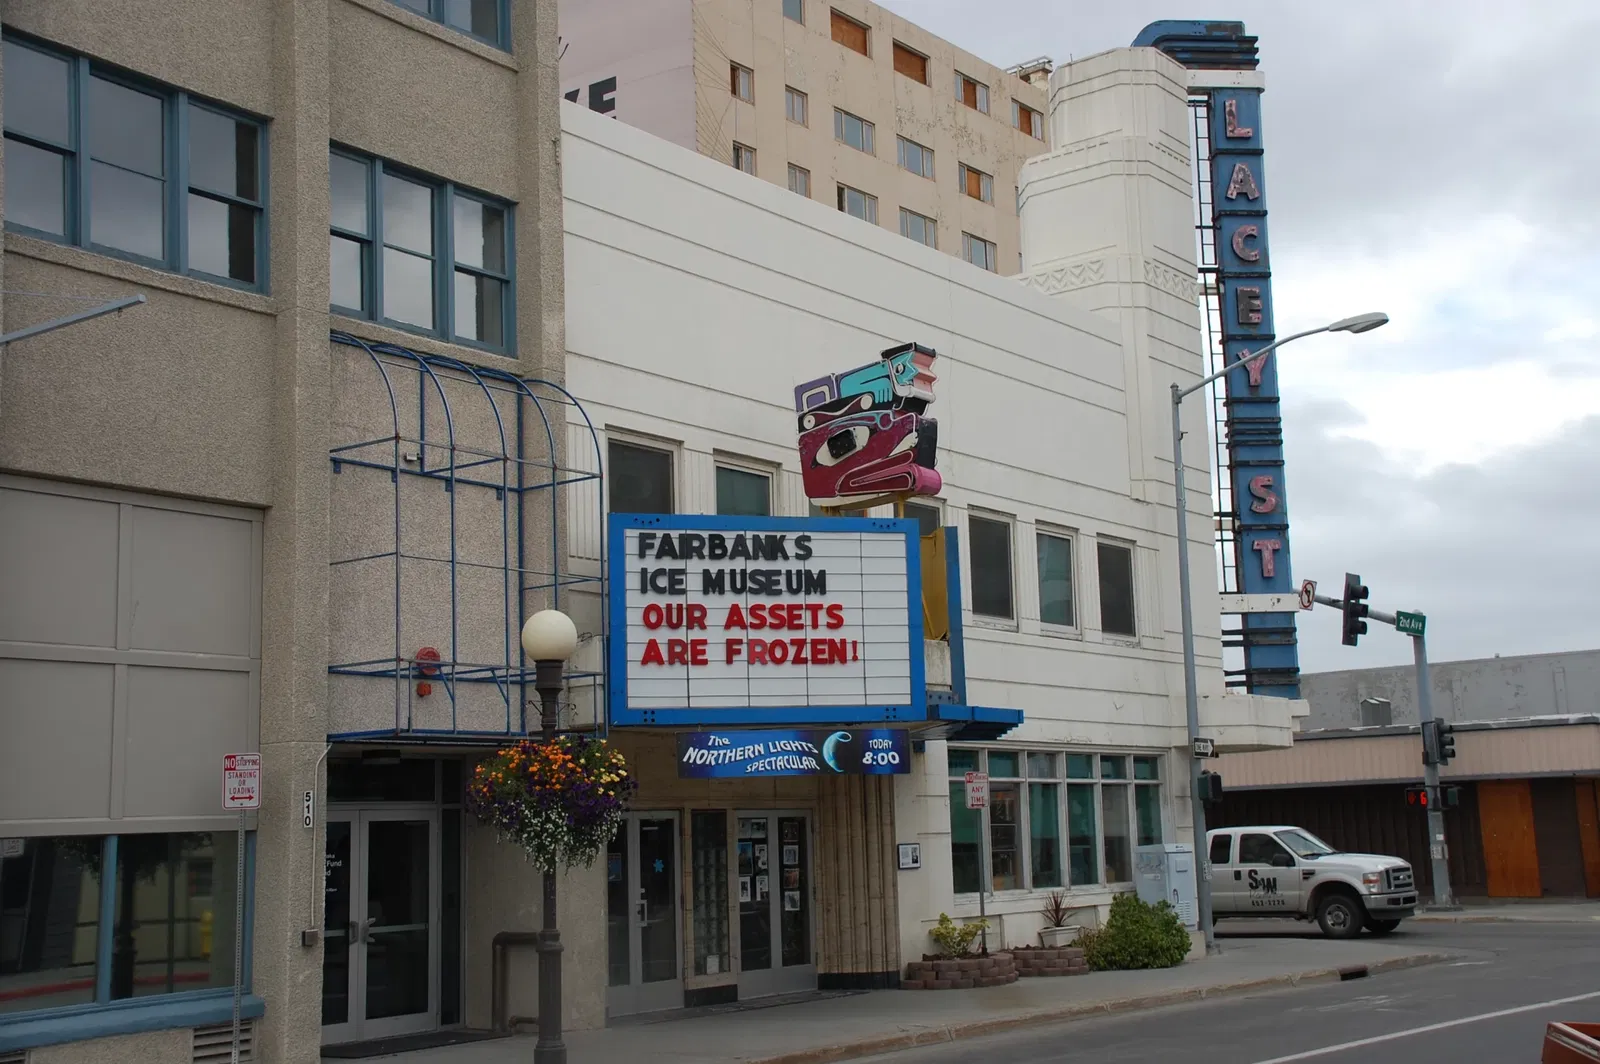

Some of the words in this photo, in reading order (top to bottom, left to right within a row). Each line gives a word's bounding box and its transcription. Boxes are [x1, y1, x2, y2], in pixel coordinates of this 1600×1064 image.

[1224, 99, 1270, 387] LACEY
[1249, 475, 1282, 578] ST
[638, 532, 813, 561] FAIRBANKS
[640, 567, 687, 595] ICE
[702, 568, 827, 596] MUSEUM
[642, 603, 708, 630] OUR
[723, 603, 845, 630] ASSETS
[1400, 616, 1410, 628] 2nd
[1411, 618, 1423, 630] Ave
[640, 638, 709, 665] ARE
[725, 638, 859, 665] FROZEN!
[708, 735, 731, 747] The
[868, 739, 893, 749] TODAY
[682, 746, 765, 765] NORTHERN
[768, 740, 820, 754] LIGHTS
[862, 752, 900, 765] 8:00
[224, 757, 236, 769] NO
[236, 758, 259, 767] STOPPING
[745, 756, 821, 773] SPECTACULAR
[228, 771, 257, 779] STANDING
[229, 786, 255, 795] LOADING
[971, 796, 985, 804] TIME
[304, 792, 312, 826] 510
